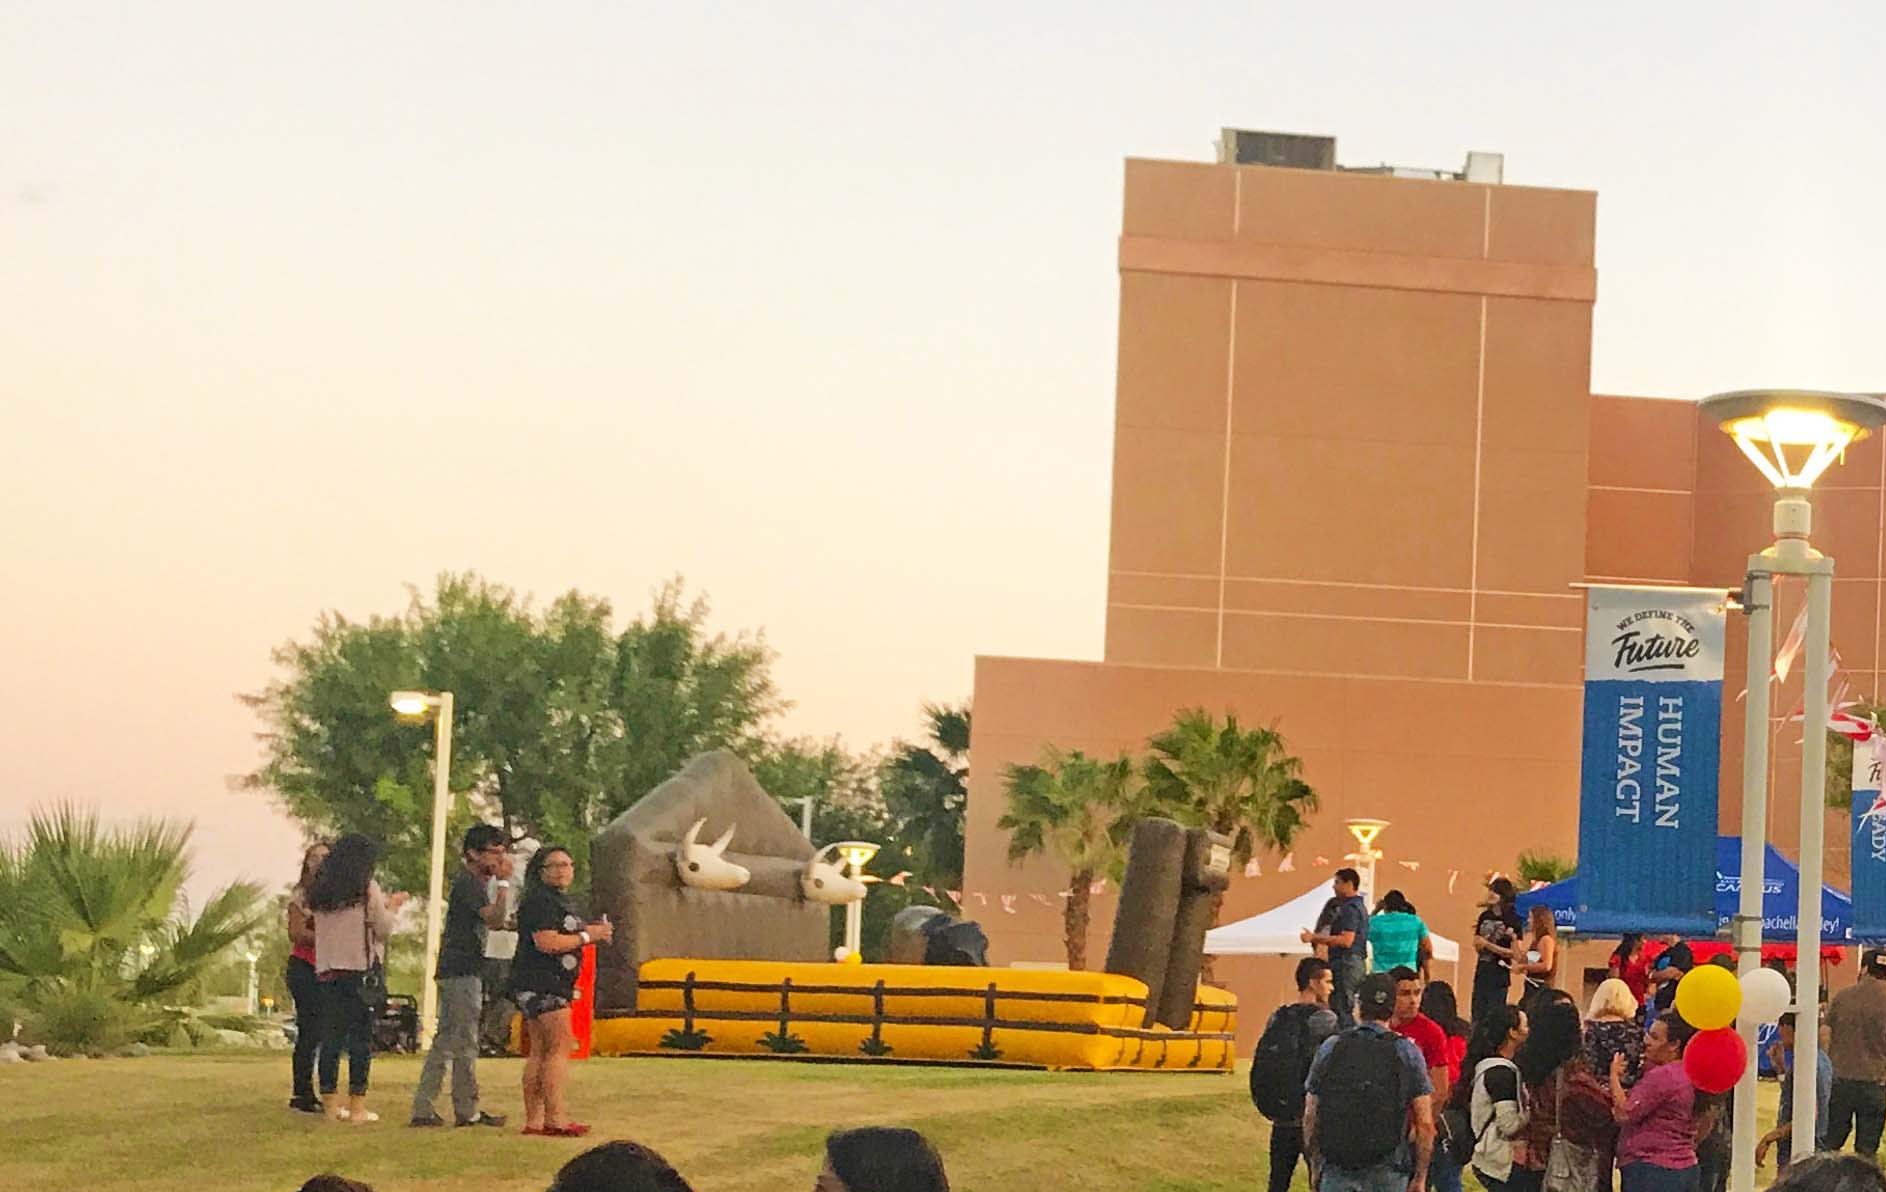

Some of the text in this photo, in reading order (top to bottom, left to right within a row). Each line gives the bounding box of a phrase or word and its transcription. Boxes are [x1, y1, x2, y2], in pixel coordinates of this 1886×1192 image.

[1616, 609, 1696, 634] WE DEFINE THE
[1611, 630, 1700, 668] Future
[1615, 695, 1644, 824] IMPACT
[1655, 695, 1683, 830] HUMAN
[1872, 808, 1886, 862] EADY
[1716, 883, 1782, 894] CAUS
